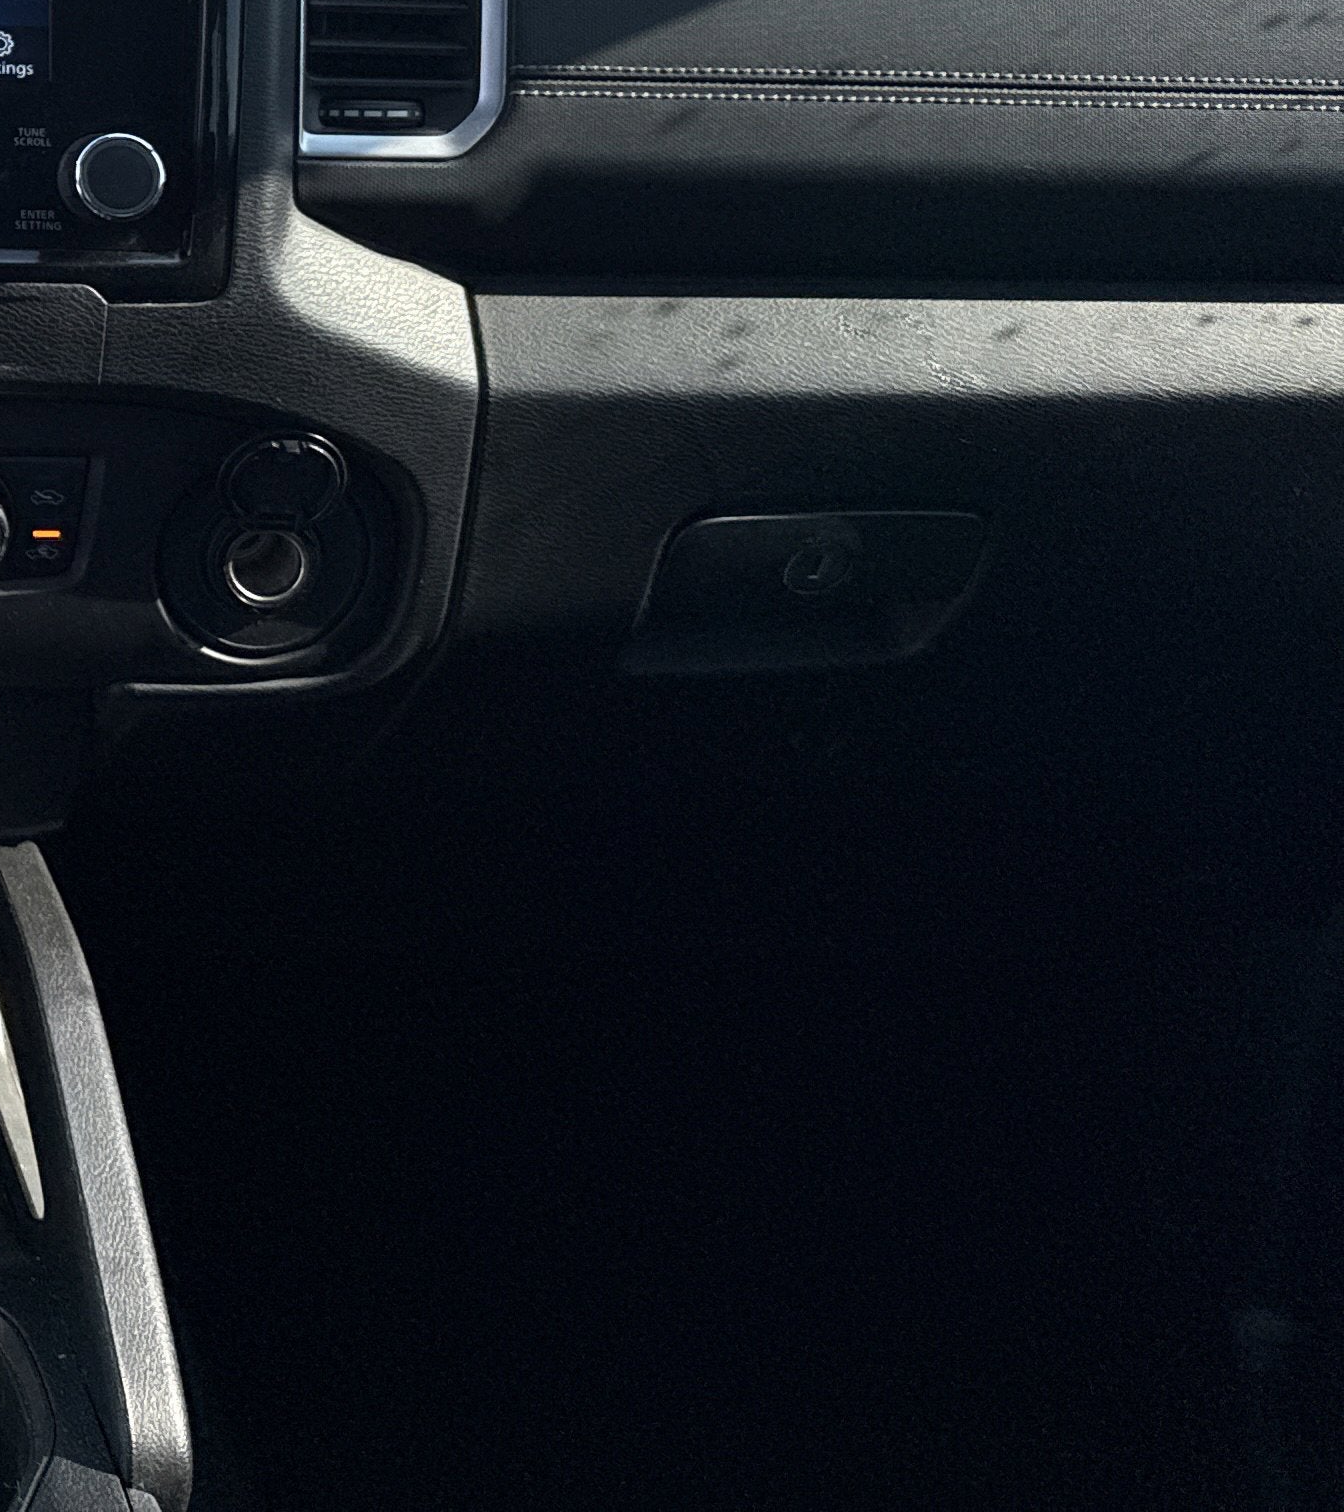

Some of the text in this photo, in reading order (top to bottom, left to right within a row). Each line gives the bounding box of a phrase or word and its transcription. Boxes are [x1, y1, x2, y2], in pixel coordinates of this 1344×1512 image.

[18, 128, 46, 137] TUNE
[13, 138, 53, 147] SCROLL
[20, 210, 56, 220] ENTER
[14, 220, 62, 231] SETTING
